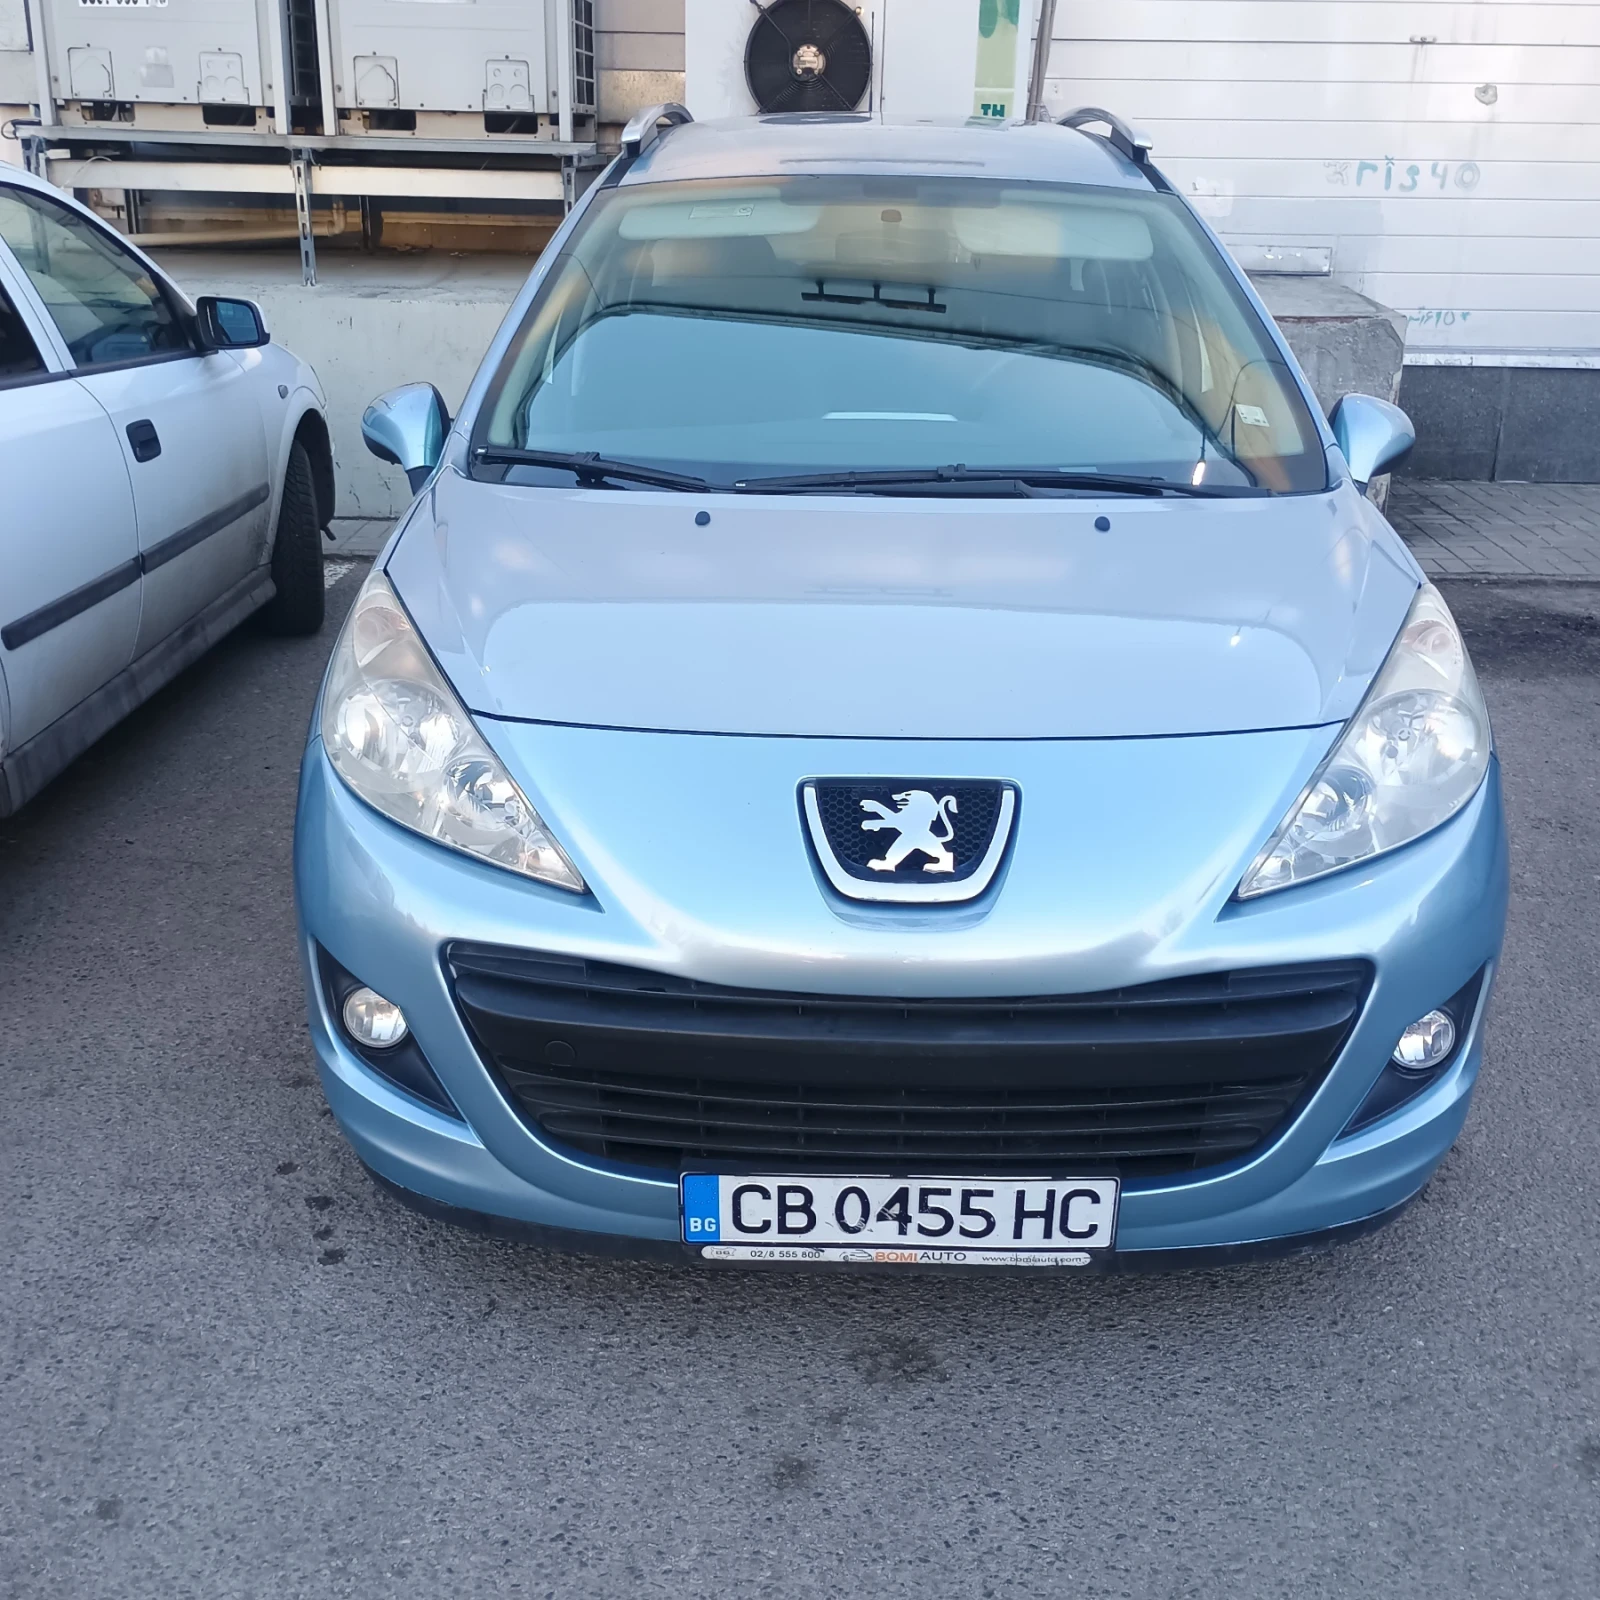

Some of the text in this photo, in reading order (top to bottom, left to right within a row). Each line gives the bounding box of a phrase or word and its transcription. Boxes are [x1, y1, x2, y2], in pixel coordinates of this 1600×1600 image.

[731, 1183, 1101, 1240] CB 0455 HC
[689, 1217, 717, 1233] BG
[750, 1250, 821, 1259] 02/8 555 800
